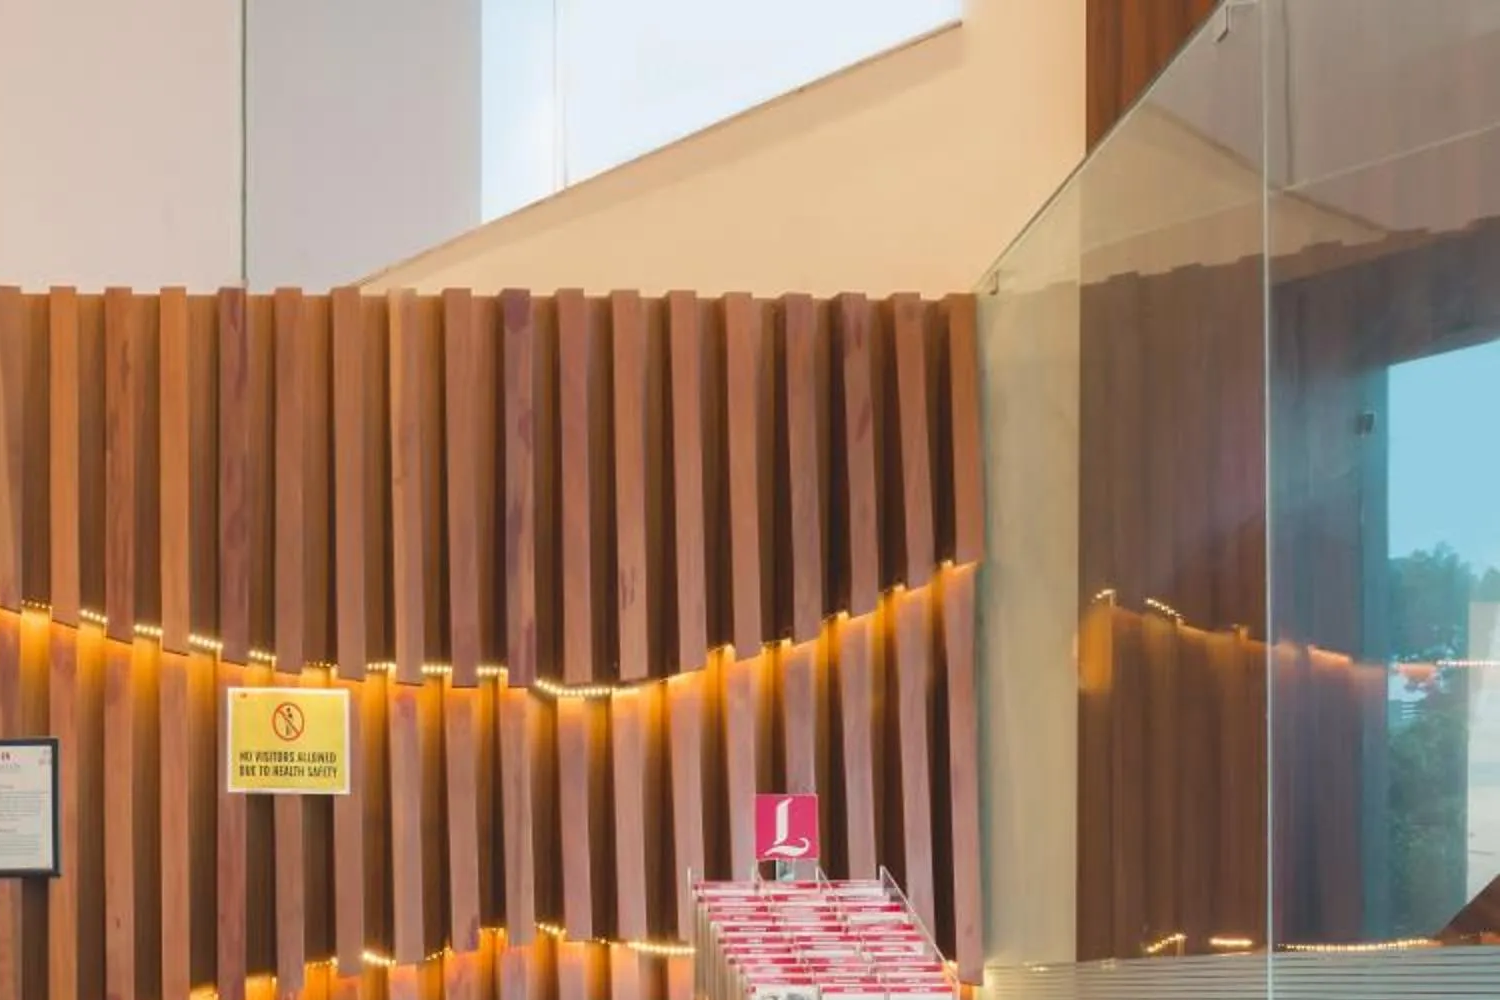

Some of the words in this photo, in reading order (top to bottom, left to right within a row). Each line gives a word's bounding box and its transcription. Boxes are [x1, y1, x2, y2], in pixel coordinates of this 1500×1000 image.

[239, 751, 253, 763] NO
[255, 751, 295, 763] VISITORS
[297, 751, 337, 763] ALLOWED
[239, 765, 256, 777] DUE
[259, 765, 271, 777] TO
[272, 765, 305, 777] HEALTH
[307, 765, 338, 778] SAFETY
